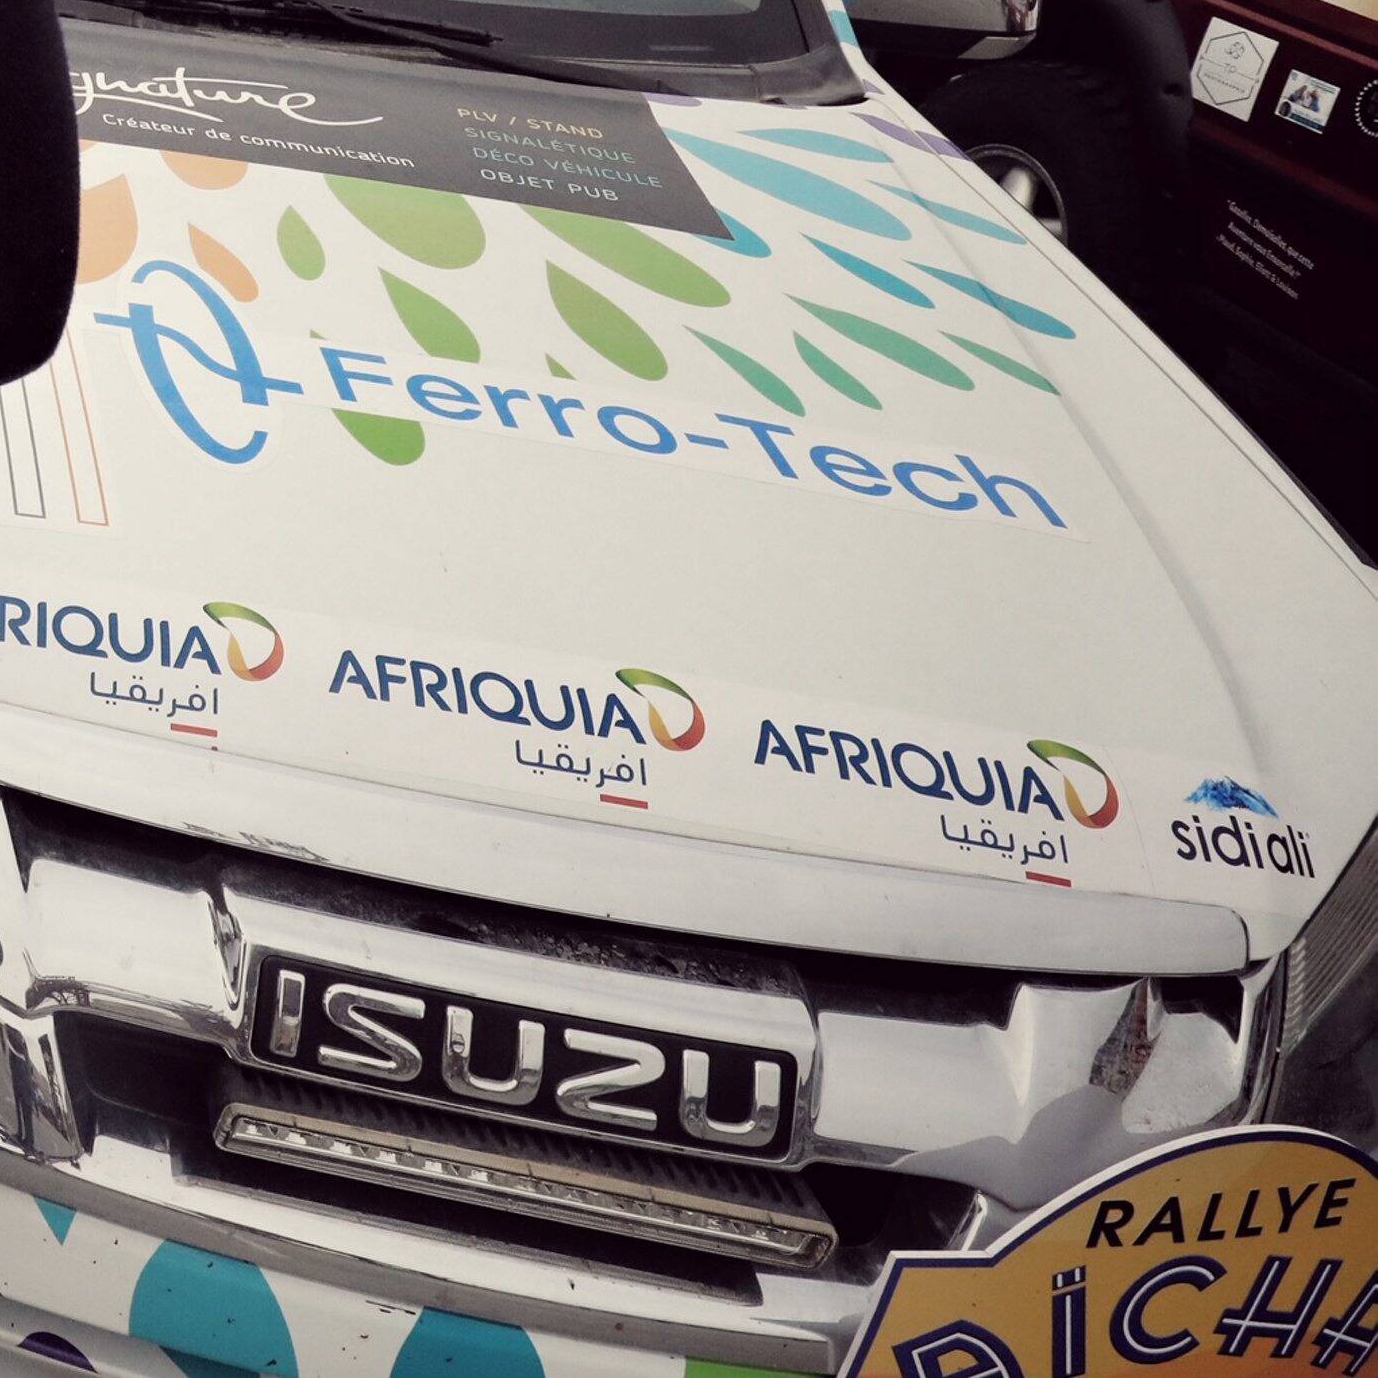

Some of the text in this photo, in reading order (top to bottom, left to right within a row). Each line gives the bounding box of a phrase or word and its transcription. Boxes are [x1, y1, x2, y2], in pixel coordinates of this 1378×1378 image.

[101, 112, 416, 169] Créateur de communication
[456, 107, 496, 125] PLV
[526, 116, 604, 140] STAND
[464, 126, 637, 165] SIGNALÉTIQUE
[472, 144, 663, 189] DÉCO VÉHICULE
[479, 167, 620, 202] OBJET PUB
[318, 345, 1069, 530] Ferro-Tech
[328, 649, 647, 745] AFRIQUIA
[753, 718, 1065, 822] AFRIQUIA
[270, 970, 786, 1148] ISUZU
[1085, 1177, 1356, 1249] RALLYE
